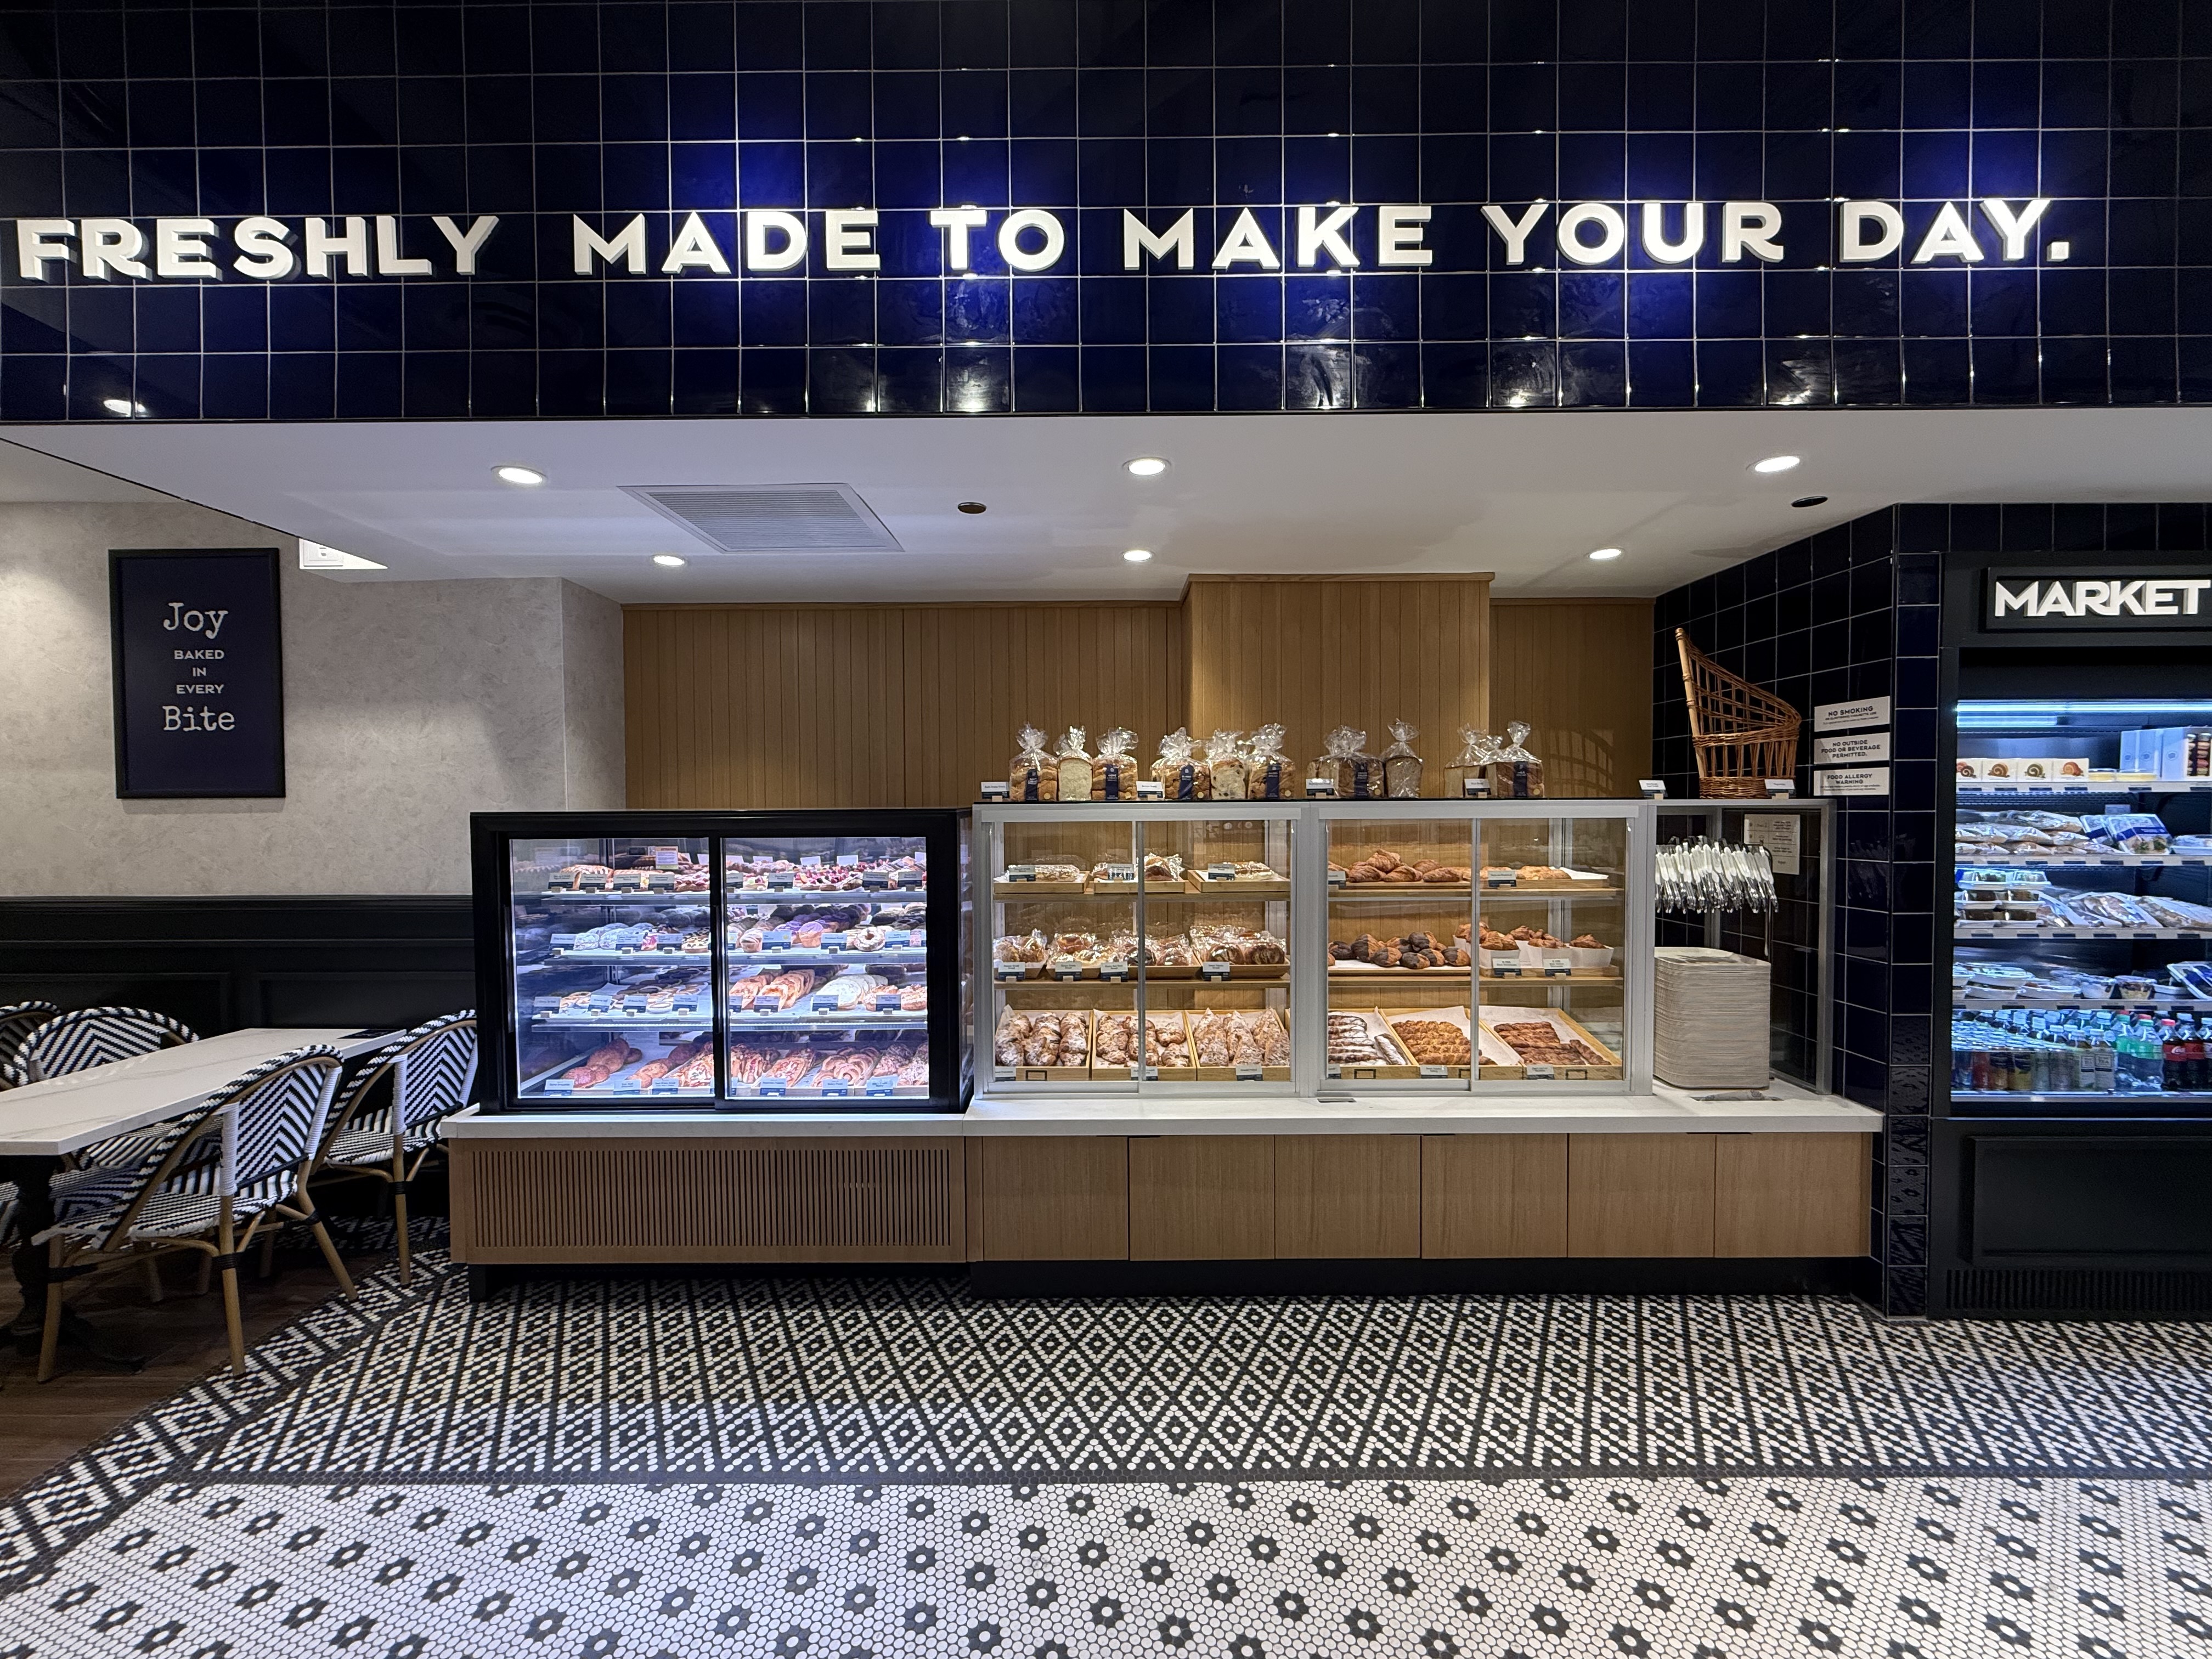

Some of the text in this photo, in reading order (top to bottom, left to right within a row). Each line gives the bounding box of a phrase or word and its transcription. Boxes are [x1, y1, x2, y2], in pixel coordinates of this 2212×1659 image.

[16, 199, 2069, 280] FRESHLY MADE TO MAKE YOUR DAY.
[1995, 580, 2211, 617] MARKET
[163, 602, 229, 639] Joy
[174, 650, 224, 659] BAKED
[193, 667, 206, 677] IN
[176, 684, 224, 694] EVERY
[162, 706, 235, 732] Bite
[1840, 706, 1874, 715] SMOKING
